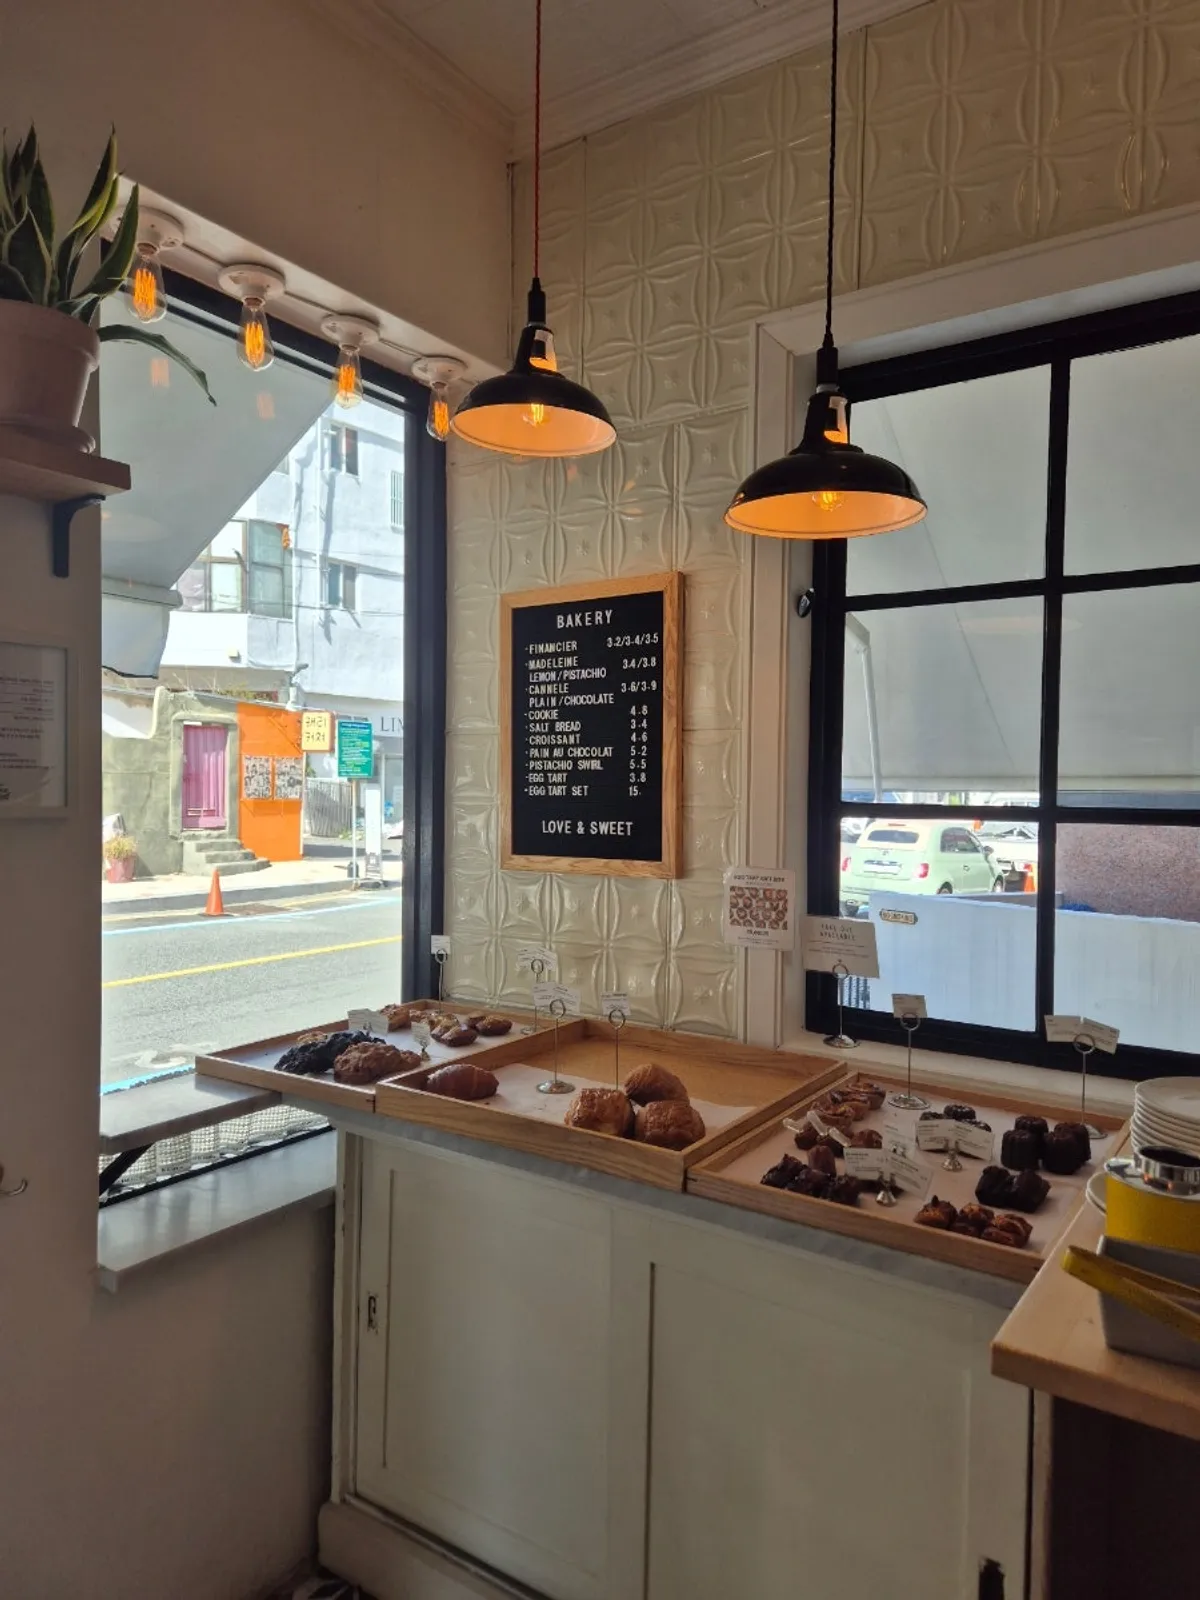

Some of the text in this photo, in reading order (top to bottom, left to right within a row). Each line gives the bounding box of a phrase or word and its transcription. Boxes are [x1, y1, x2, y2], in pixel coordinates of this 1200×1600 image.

[556, 609, 613, 629] BAKERY
[529, 640, 578, 654] FINANCIER
[528, 656, 657, 670] MADELEINE 3.4/3.8
[529, 680, 657, 695] CANNELE 3.6/3.9
[528, 709, 559, 720] COOKIE
[529, 718, 648, 733] SALT BREAD 3.4
[529, 731, 648, 746] CROISSANT 4.6
[529, 745, 648, 759] PAIN AU CHOCOLAT 5.2
[529, 760, 573, 771] PISTACHIO
[528, 772, 647, 783] EGG TART 3.8
[528, 786, 546, 796] EGG
[547, 785, 567, 796] TART
[571, 785, 589, 796] SET
[542, 820, 633, 836] LOVE & SWEET
